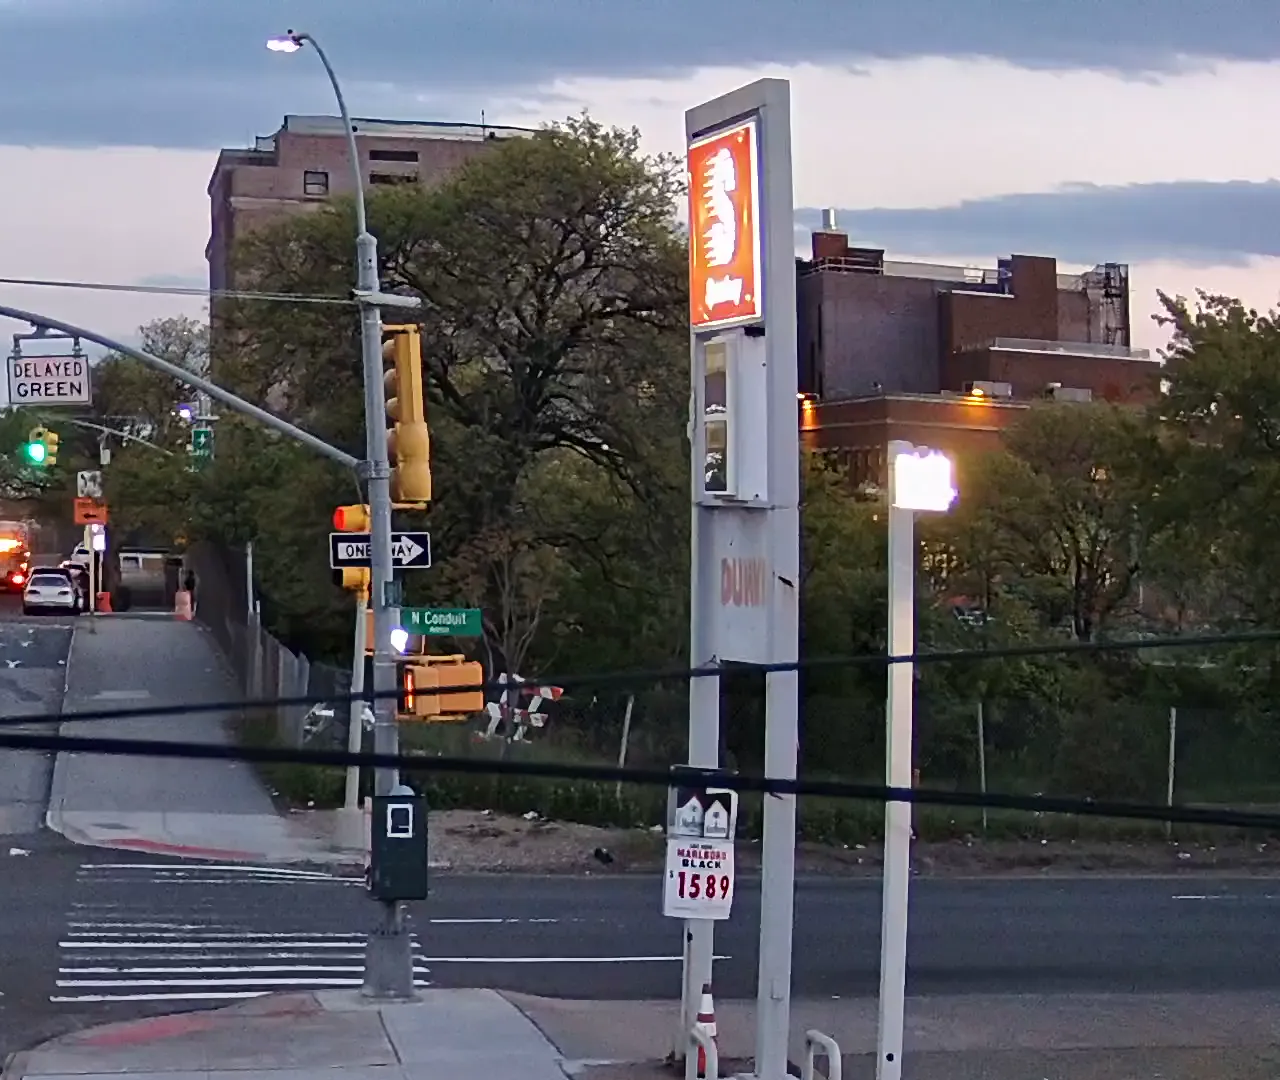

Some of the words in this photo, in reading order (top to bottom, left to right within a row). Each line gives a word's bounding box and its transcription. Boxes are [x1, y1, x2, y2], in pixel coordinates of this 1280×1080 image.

[14, 362, 82, 378] DELAYED
[17, 382, 82, 397] GREEN
[346, 544, 371, 557] ONE
[411, 611, 420, 624] N
[424, 611, 467, 626] Conduit
[682, 858, 721, 869] BLACK
